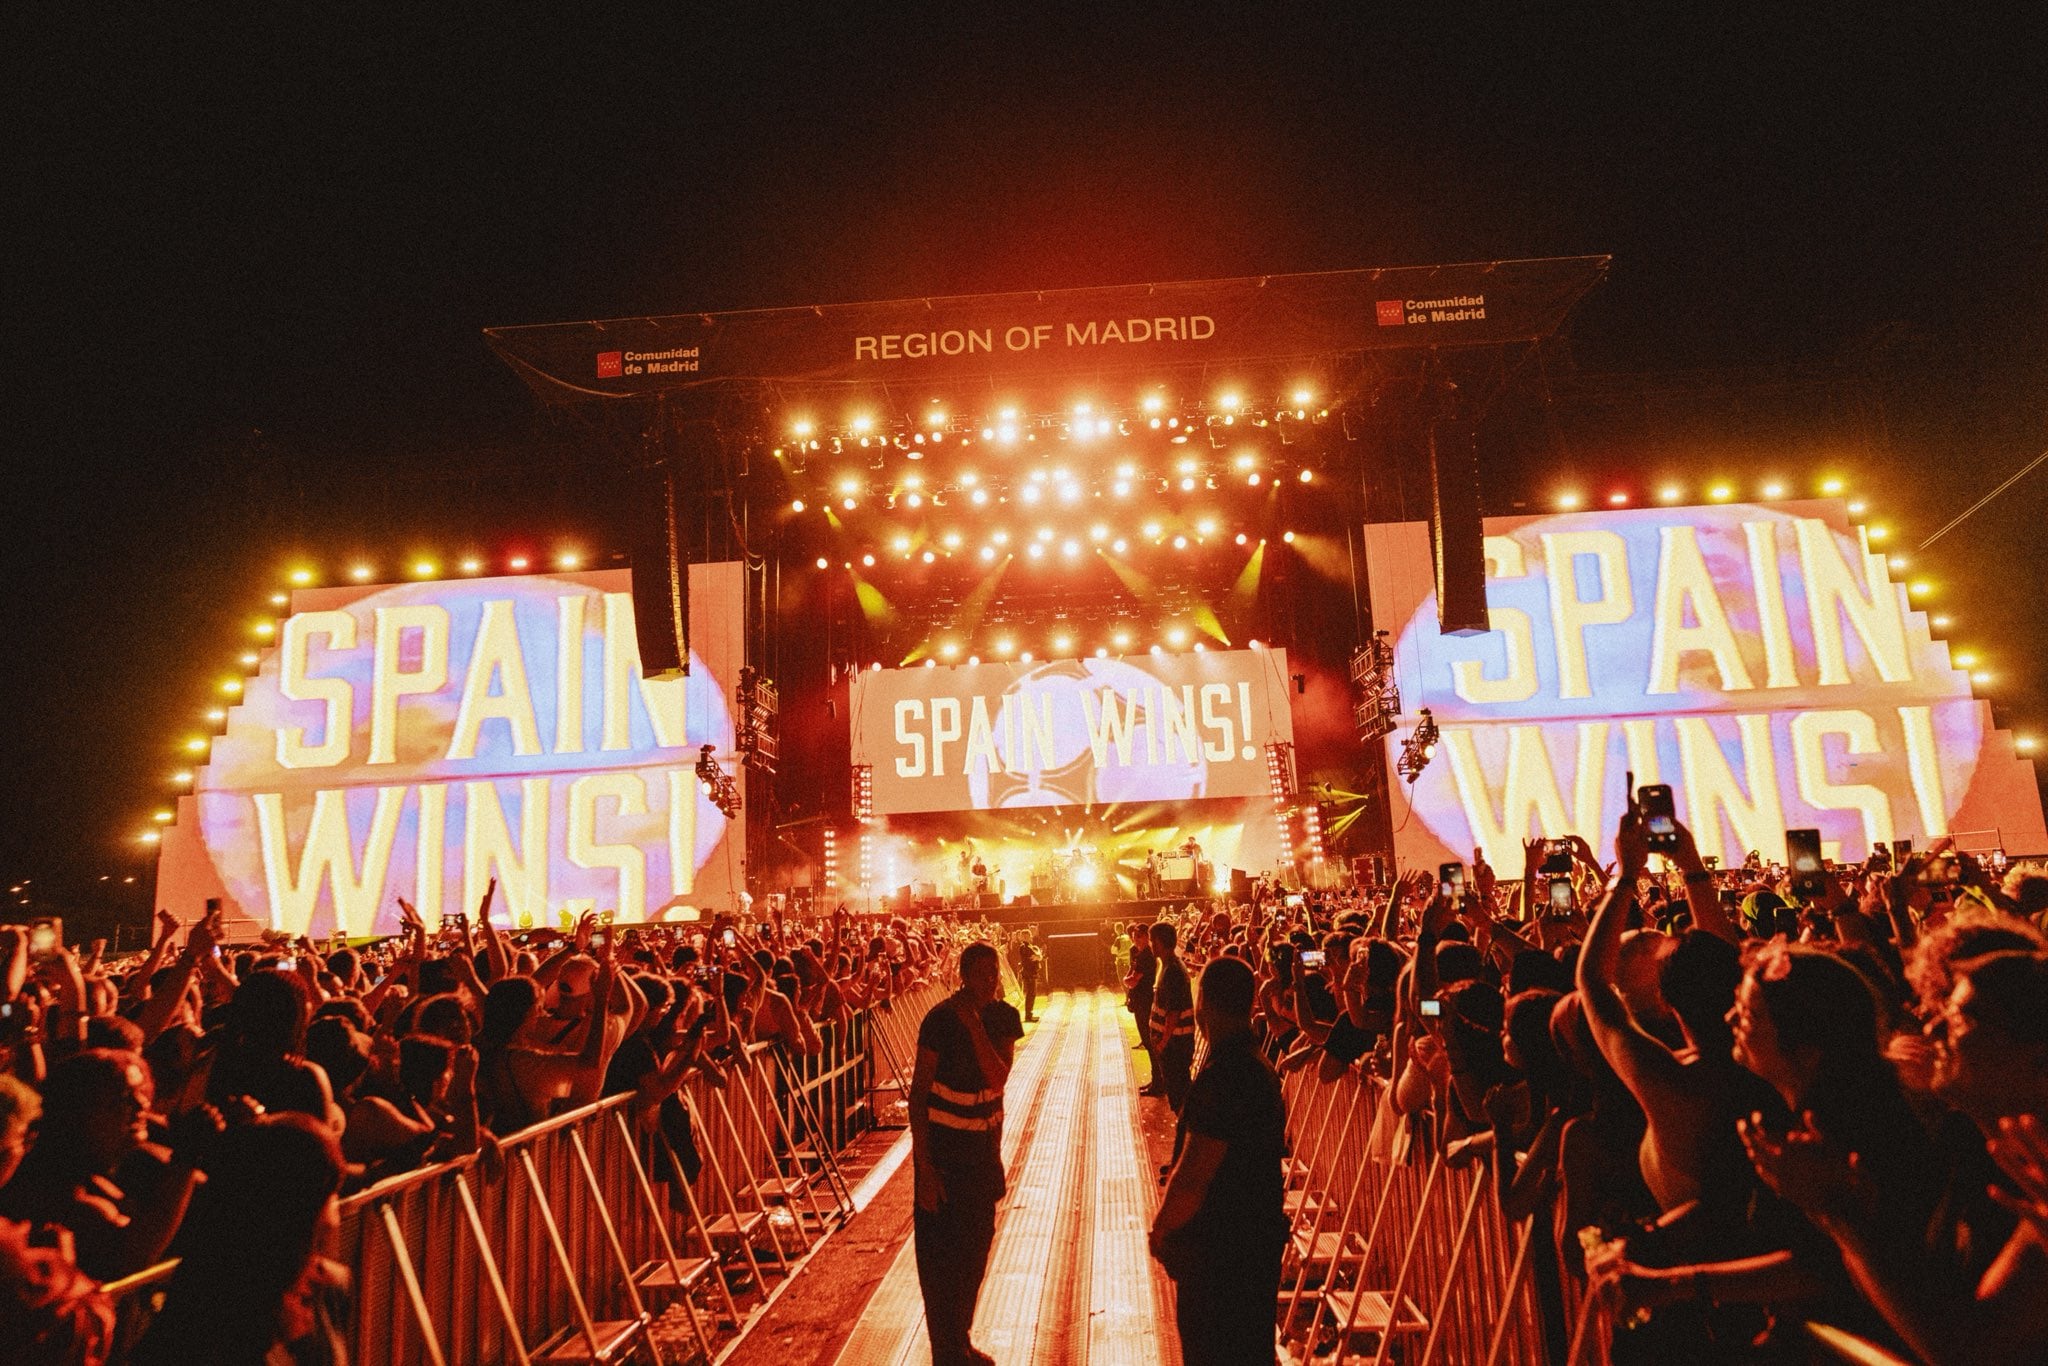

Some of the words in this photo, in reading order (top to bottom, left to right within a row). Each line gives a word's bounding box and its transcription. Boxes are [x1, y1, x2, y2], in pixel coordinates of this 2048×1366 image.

[1405, 295, 1484, 310] Comunidad
[1407, 313, 1427, 324] de
[1431, 308, 1485, 322] Madrid
[624, 347, 699, 361] Comunidad
[855, 329, 992, 360] REGION
[1005, 325, 1053, 351] OF
[1066, 315, 1215, 346] MADRID
[624, 364, 642, 375] de
[647, 361, 699, 374] Madrid
[1450, 518, 1914, 704] SPAIN
[275, 592, 688, 769] SPAIN
[894, 693, 1055, 778] SPAIN
[1079, 682, 1256, 768] WINS!
[253, 770, 701, 938] WINS!
